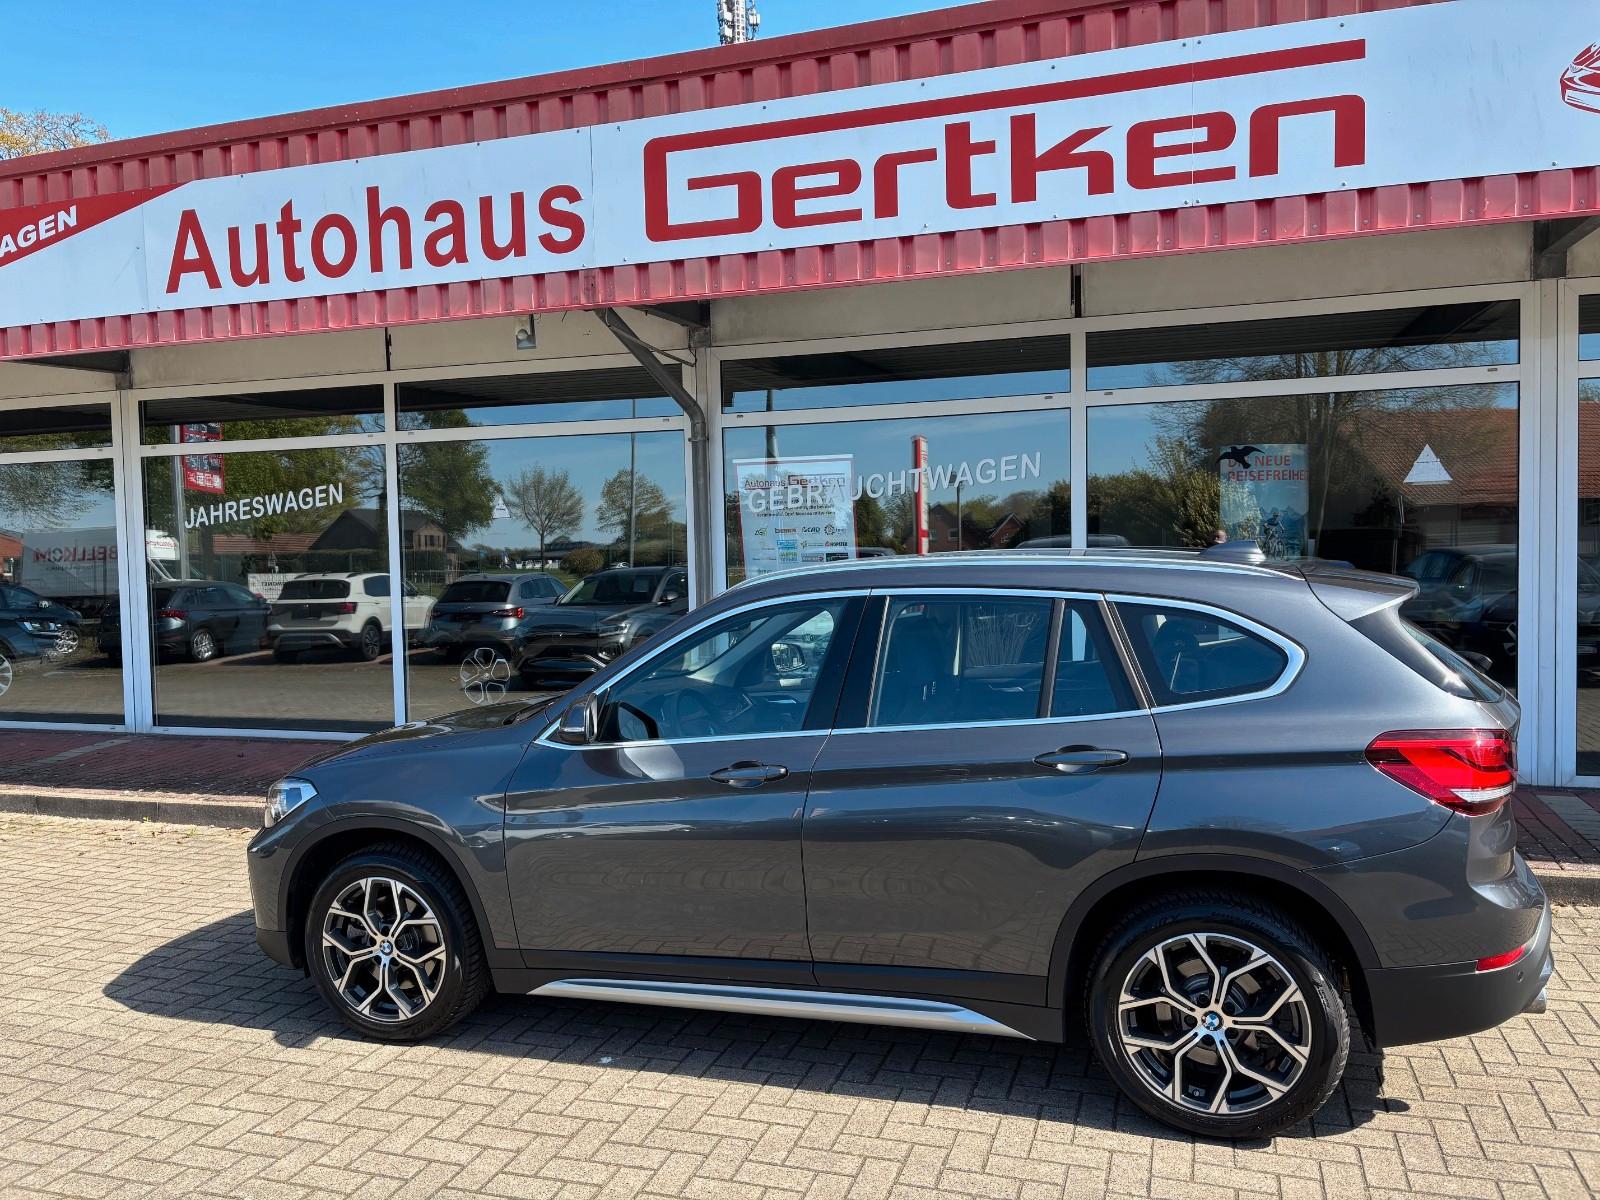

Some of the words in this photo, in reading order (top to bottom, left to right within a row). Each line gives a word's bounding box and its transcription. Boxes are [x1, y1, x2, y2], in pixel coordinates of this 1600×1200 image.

[165, 184, 586, 294] Autohaus
[643, 38, 1366, 242] Gertken
[749, 451, 1042, 514] GEBRAUCHTWAGEN
[1255, 455, 1291, 466] NEUE
[184, 482, 344, 529] JAHRESWAGEN
